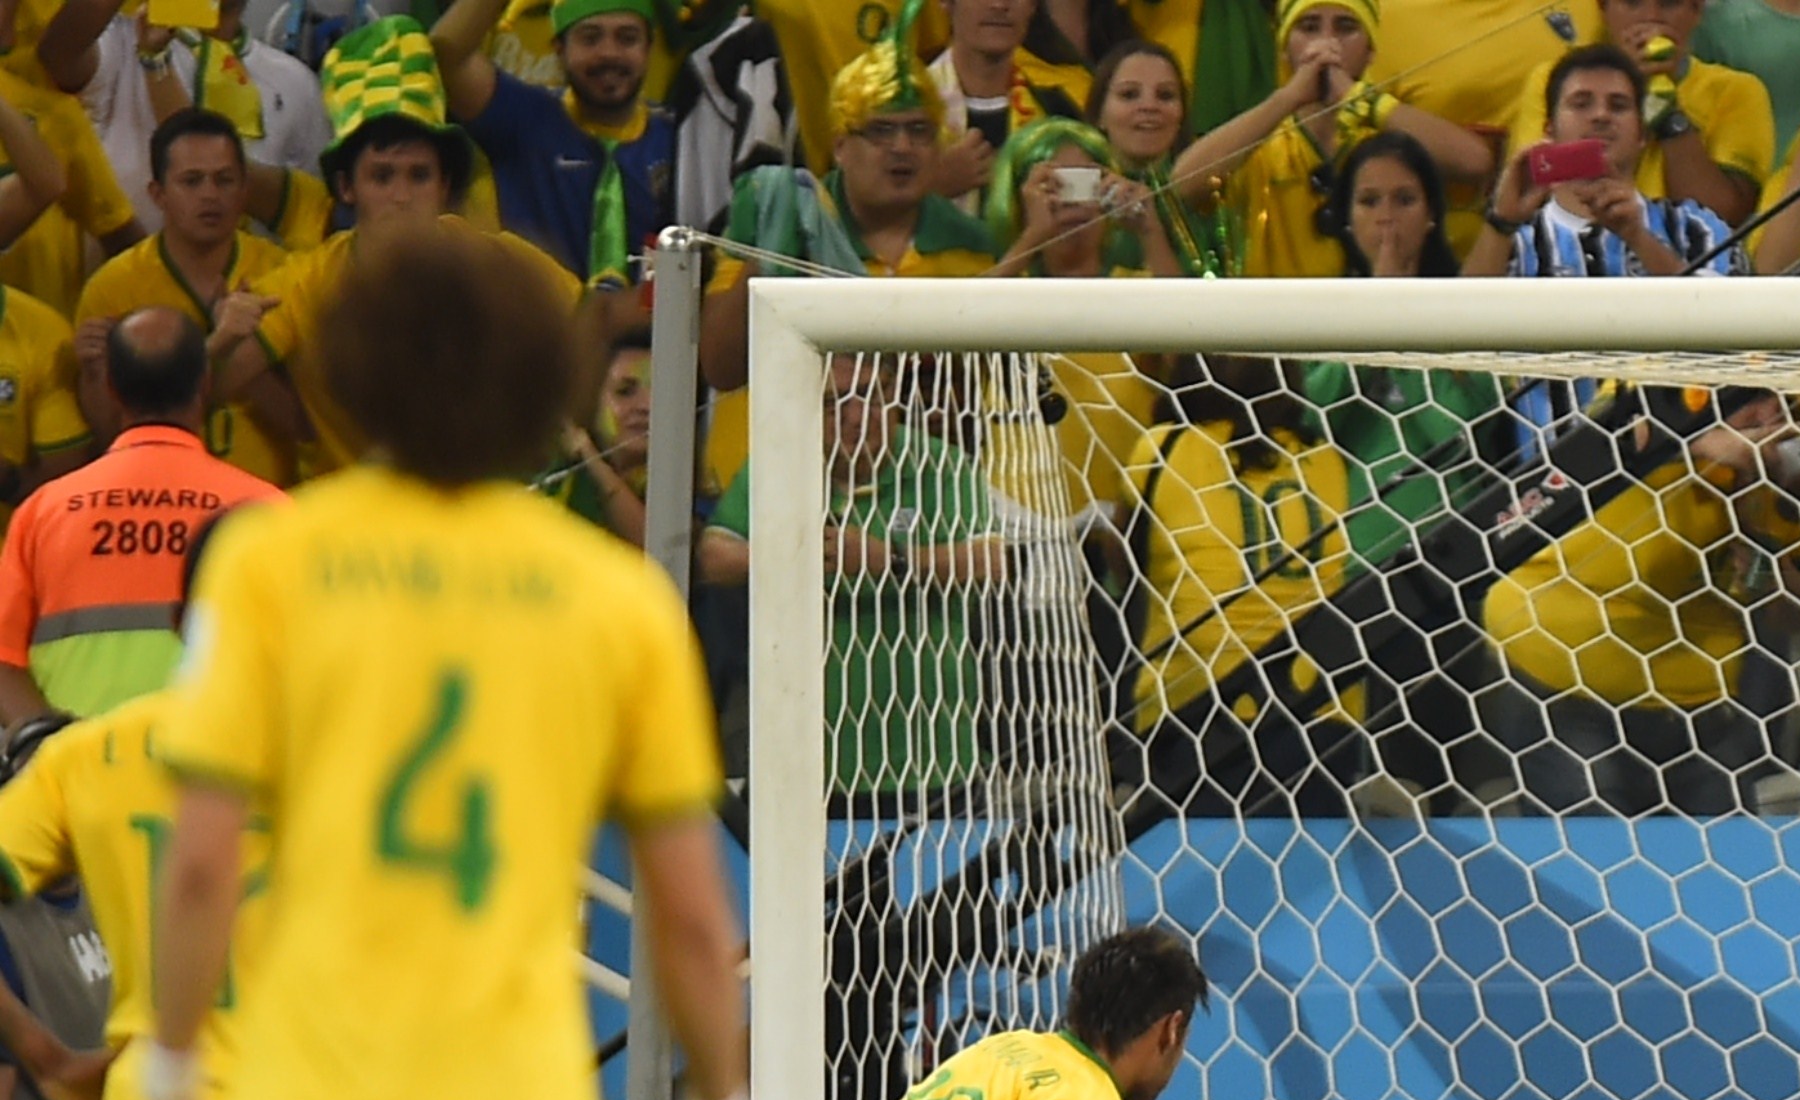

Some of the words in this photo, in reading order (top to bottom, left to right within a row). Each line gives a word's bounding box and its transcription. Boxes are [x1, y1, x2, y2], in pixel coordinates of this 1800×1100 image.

[67, 488, 221, 512] STEWARD
[91, 520, 188, 555] 2808
[373, 664, 500, 908] 4
